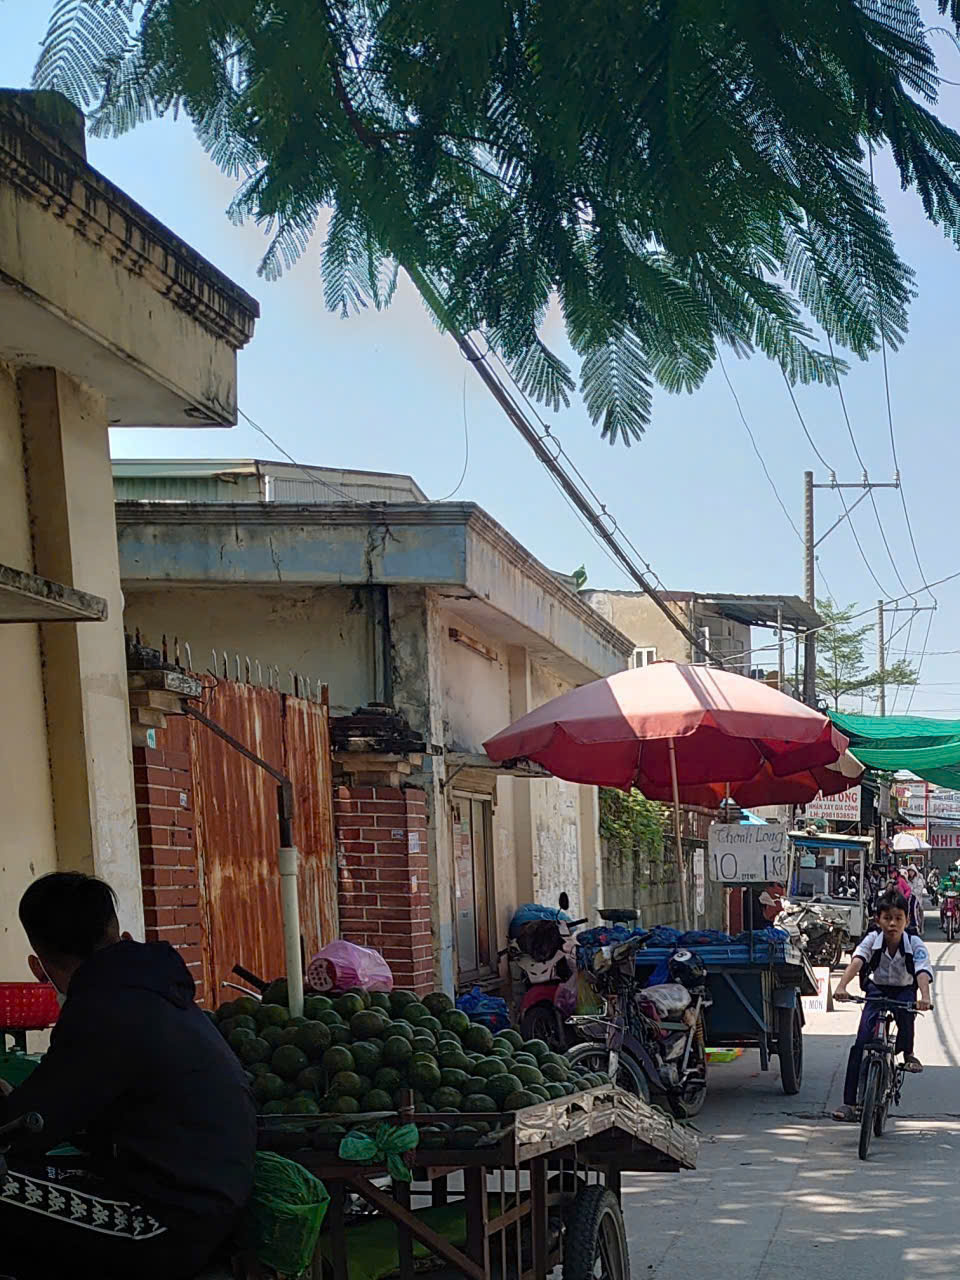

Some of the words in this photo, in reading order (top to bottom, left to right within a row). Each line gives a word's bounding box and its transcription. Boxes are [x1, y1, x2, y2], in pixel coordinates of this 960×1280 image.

[755, 827, 785, 853] Long
[932, 834, 951, 847] NHI
[713, 852, 738, 881] 10
